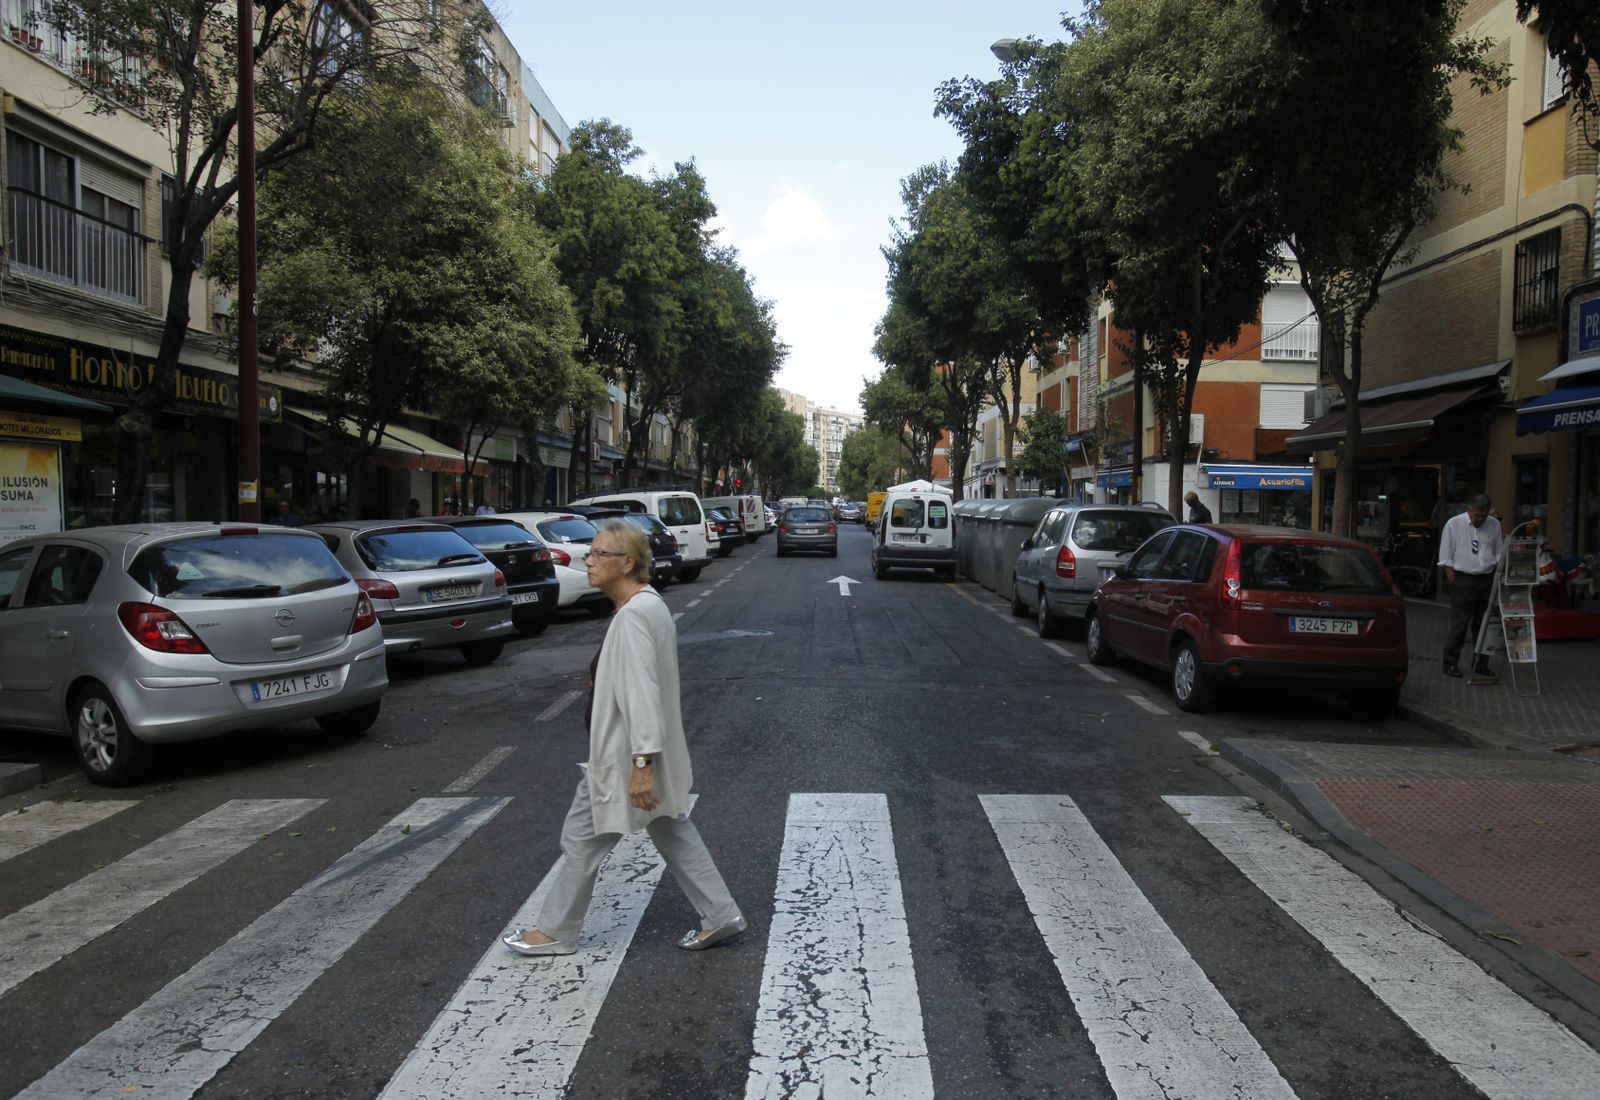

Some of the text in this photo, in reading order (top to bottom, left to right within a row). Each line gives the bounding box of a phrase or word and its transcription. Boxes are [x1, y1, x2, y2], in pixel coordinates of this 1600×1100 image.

[69, 347, 143, 390] HORNO
[2, 475, 48, 488] ILUSIÓN
[1, 490, 34, 501] SUMA
[1299, 619, 1353, 633] 3245 FZP
[264, 674, 329, 698] 7241 FJG
